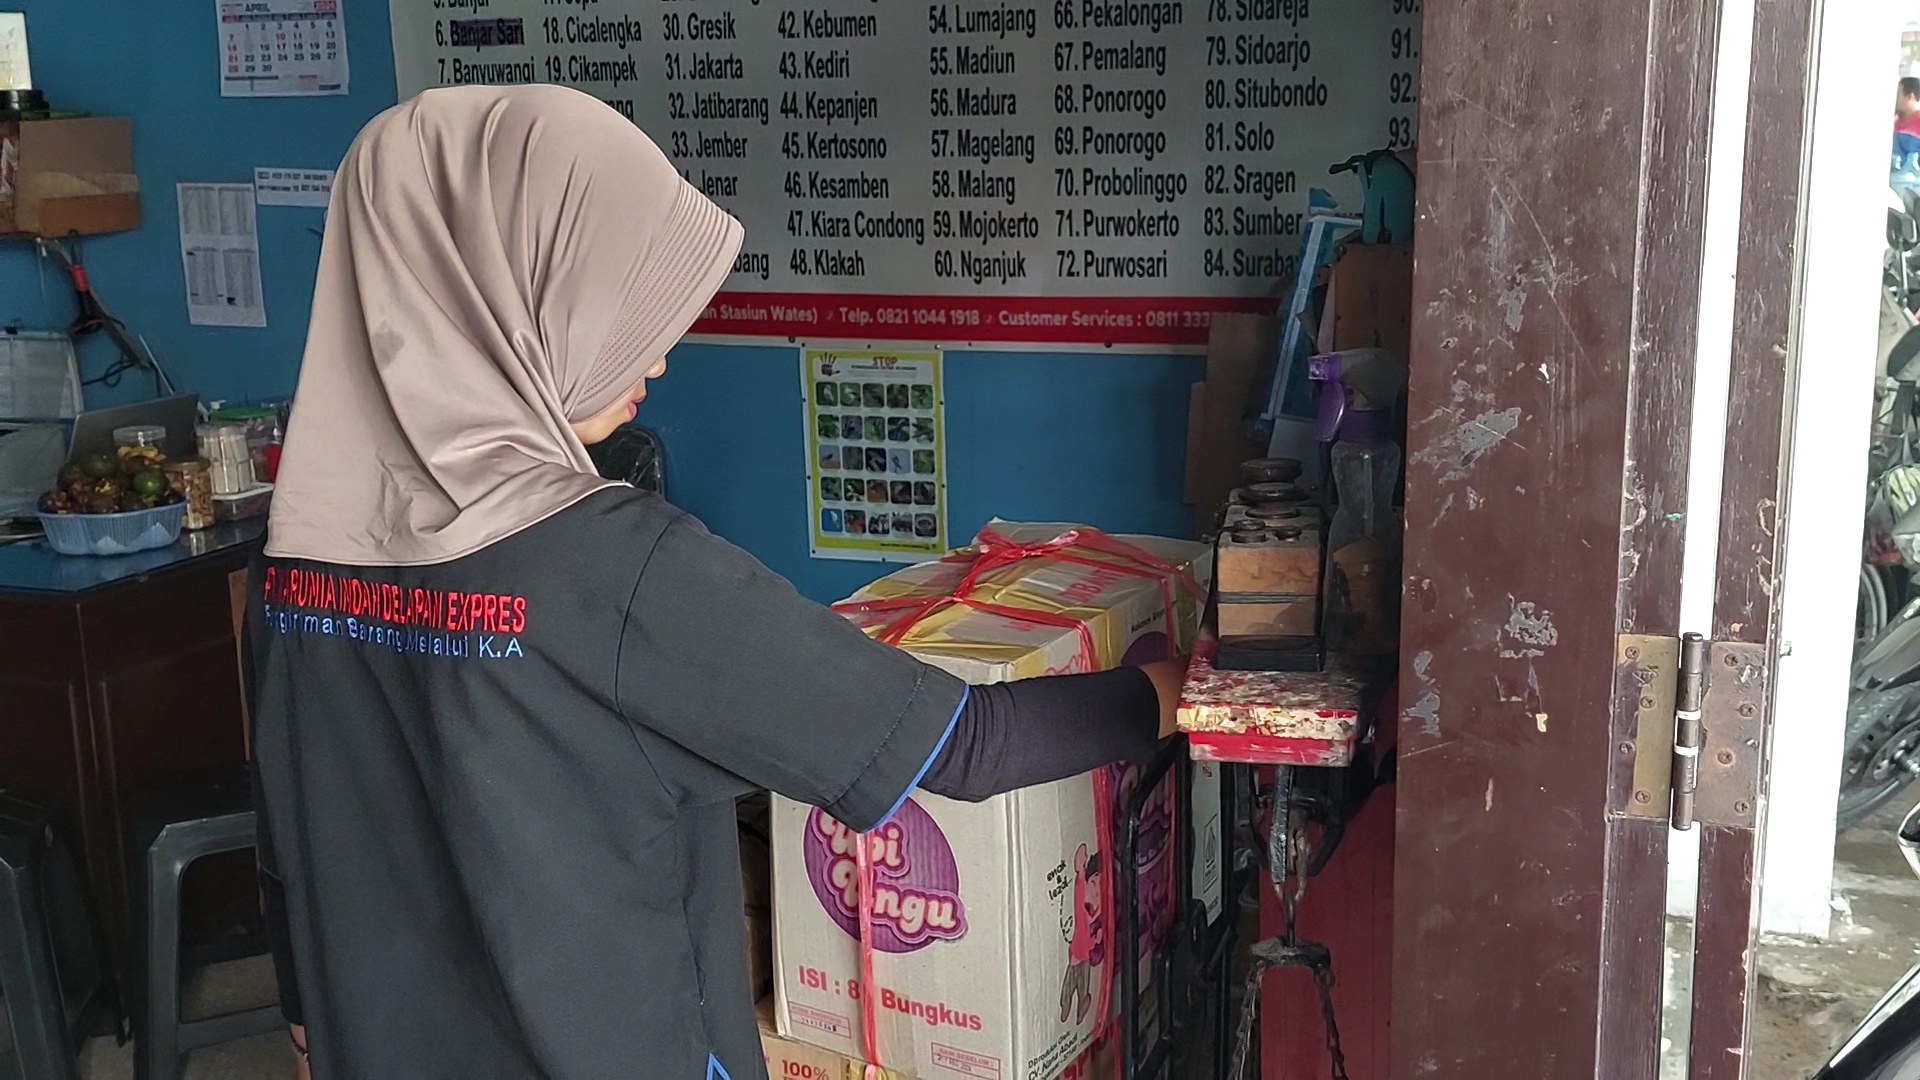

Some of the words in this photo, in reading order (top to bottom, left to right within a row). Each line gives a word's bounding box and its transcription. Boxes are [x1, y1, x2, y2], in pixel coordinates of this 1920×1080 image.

[663, 13, 684, 41] 30.
[688, 12, 736, 40] Gresik
[778, 11, 800, 38] 42.
[804, 10, 876, 38] Kebumen
[929, 5, 951, 34] 54.
[956, 2, 1035, 39] Lumajang
[1055, 0, 1078, 29] 66.
[1083, 0, 1182, 33] Pekalongan
[1208, 0, 1231, 22] 78.
[1236, 0, 1308, 27] Sidareja
[436, 20, 447, 46] 6.
[543, 17, 563, 44] 18.
[566, 15, 641, 49] Cicalengka
[1392, 27, 1417, 59] 91.
[665, 53, 686, 80] 31.
[689, 52, 743, 80] Jakarta
[779, 51, 801, 79] 43.
[805, 50, 849, 78] Kediri
[930, 47, 952, 75] 55.
[957, 45, 1014, 74] Madiun
[1055, 42, 1078, 71] 67.
[1083, 40, 1166, 76] Pemalang
[1206, 36, 1230, 65] 79.
[1235, 33, 1310, 71] Sidoarjo
[438, 59, 450, 84] 7.
[453, 57, 535, 84] Banyuwangi
[545, 56, 565, 82] 19.
[569, 54, 638, 88] Cikampek
[931, 88, 953, 117] 56.
[957, 87, 1016, 116] Madura
[1055, 84, 1078, 113] 68.
[1083, 84, 1166, 119] Ponorogo
[1205, 79, 1230, 109] 80.
[1235, 76, 1327, 108] Situbondo
[1390, 73, 1416, 104] 92.
[669, 92, 689, 119] 32.
[692, 92, 768, 125] Jatibarang
[780, 92, 802, 119] 44.
[806, 91, 877, 126] Kepanjen
[672, 131, 692, 158] 33.
[696, 131, 747, 158] Jember
[782, 132, 804, 159] 45.
[807, 131, 886, 158] Kertosono
[932, 130, 954, 157] 57.
[958, 128, 1034, 164] Magelang
[1055, 126, 1078, 155] 69.
[1083, 126, 1165, 161] Ponorogo
[1205, 122, 1230, 152] 81.
[1235, 122, 1274, 151] Solo
[1389, 117, 1415, 147] 93.
[699, 170, 738, 196] Jenar
[785, 171, 806, 198] 46.
[809, 171, 888, 198] Kesamben
[933, 170, 954, 198] 58.
[959, 170, 1015, 205] Malang
[1055, 168, 1078, 196] 70.
[1083, 167, 1187, 203] Probolinggo
[1205, 165, 1229, 194] 82.
[1234, 164, 1295, 201] Sragen
[788, 210, 808, 236] 47.
[811, 211, 850, 237] Kiara
[855, 211, 924, 245] Condong
[934, 211, 955, 238] 59.
[960, 211, 1038, 245] Mojokerto
[1056, 209, 1079, 237] 71.
[1084, 209, 1179, 237] Purwokerto
[1204, 207, 1228, 236] 83.
[1233, 206, 1303, 236] Sumber
[790, 249, 811, 275] 48.
[814, 249, 864, 276] Klakah
[935, 250, 957, 277] 60.
[961, 250, 1026, 285] Nganjuk
[1057, 250, 1079, 277] 72.
[1084, 250, 1167, 278] Purwosari
[1204, 248, 1229, 277] 84.
[1233, 249, 1299, 277] Suraba
[720, 304, 767, 321] Stasiun
[770, 306, 818, 325] Wates)
[840, 307, 873, 325] Telp.
[877, 308, 909, 324] 0821
[913, 309, 946, 325] 1044
[950, 310, 979, 325] 1918
[999, 310, 1068, 326] Customer
[1072, 310, 1133, 327] Services
[1145, 311, 1178, 327] 0811
[339, 577, 380, 617] INDAH
[381, 584, 443, 629] DELAPAN
[446, 592, 526, 633] EXPRES
[346, 617, 403, 653] Barang
[405, 630, 469, 657] Melalui
[798, 965, 827, 991] ISI
[847, 979, 869, 1001] 8
[881, 988, 982, 1031] Bungkus
